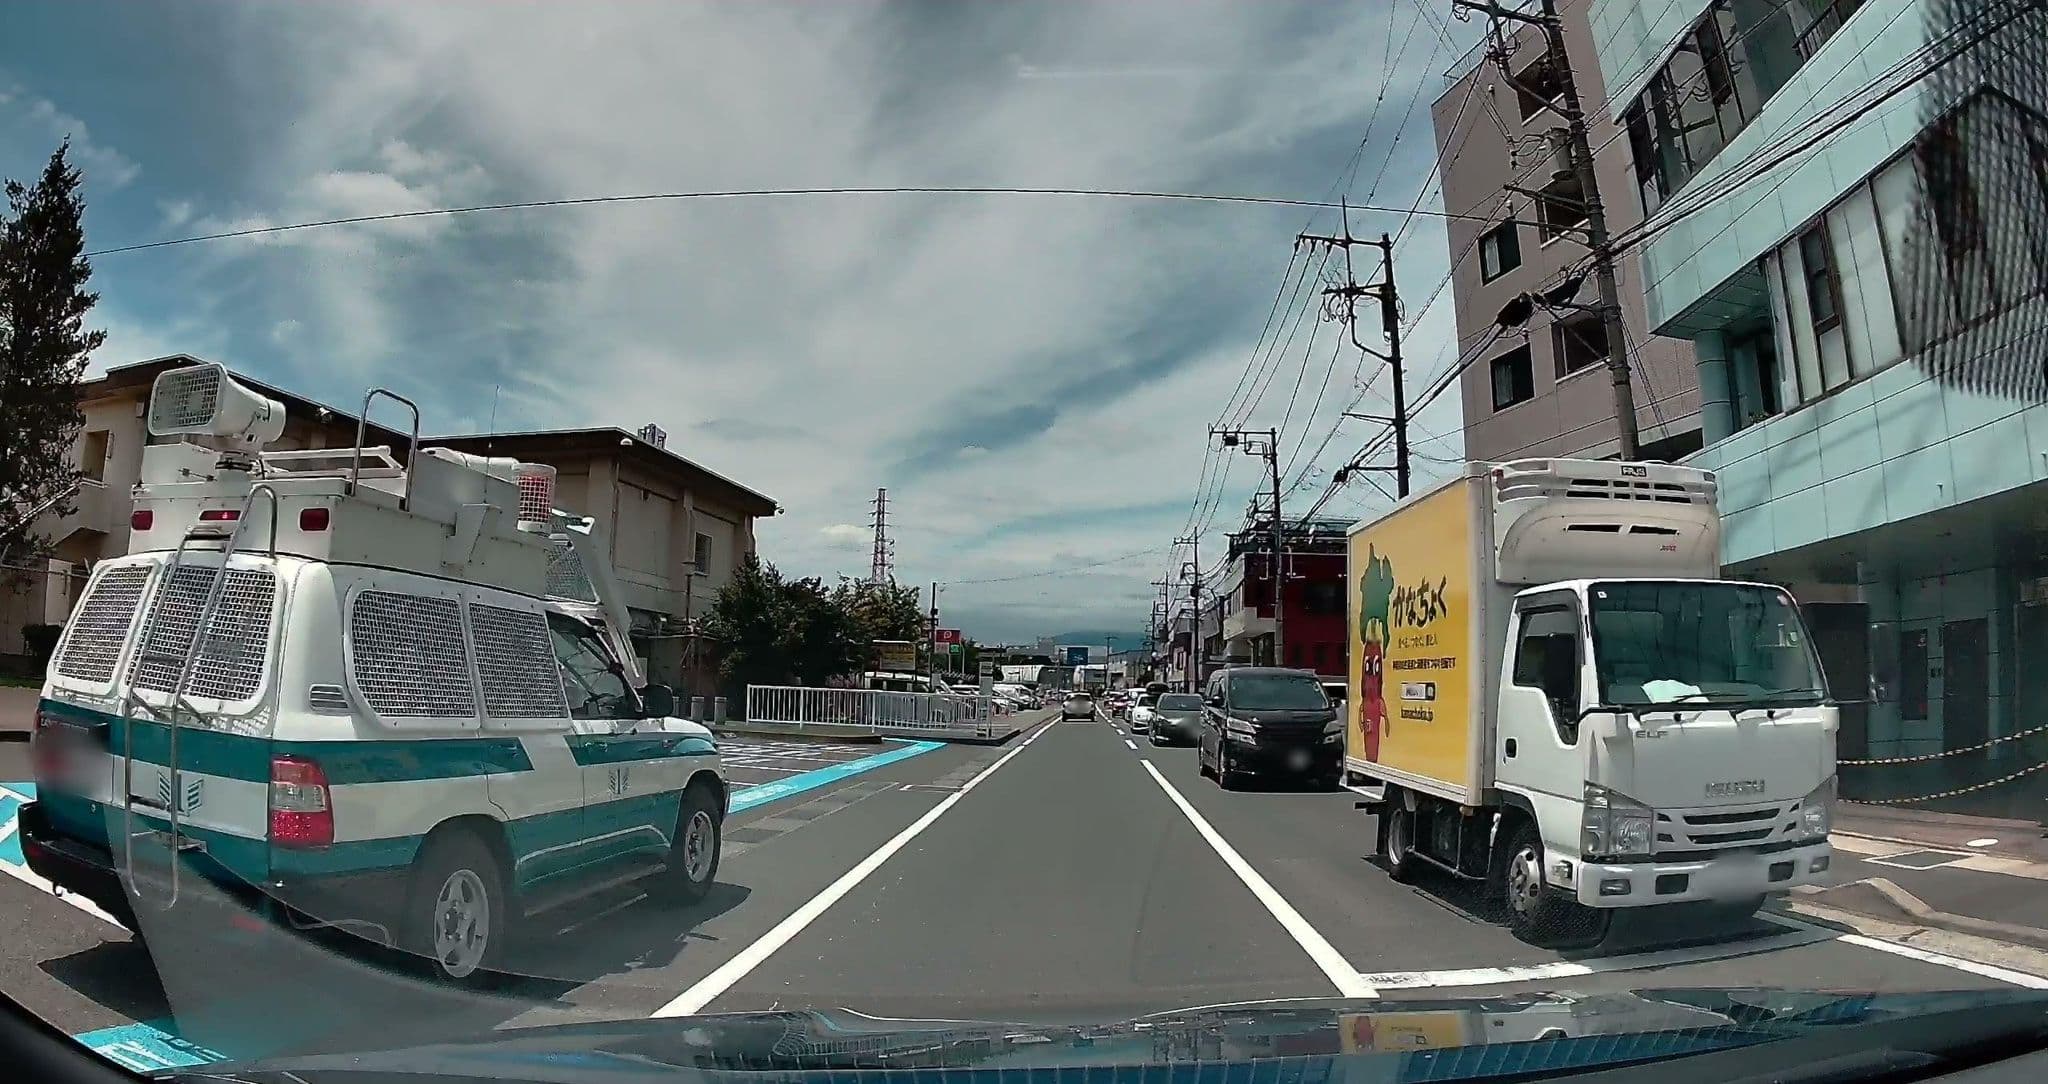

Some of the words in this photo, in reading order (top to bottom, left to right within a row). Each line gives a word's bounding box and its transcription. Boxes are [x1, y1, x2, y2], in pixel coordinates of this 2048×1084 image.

[1393, 575, 1447, 628] かなちょく
[1636, 730, 1668, 739] ELF
